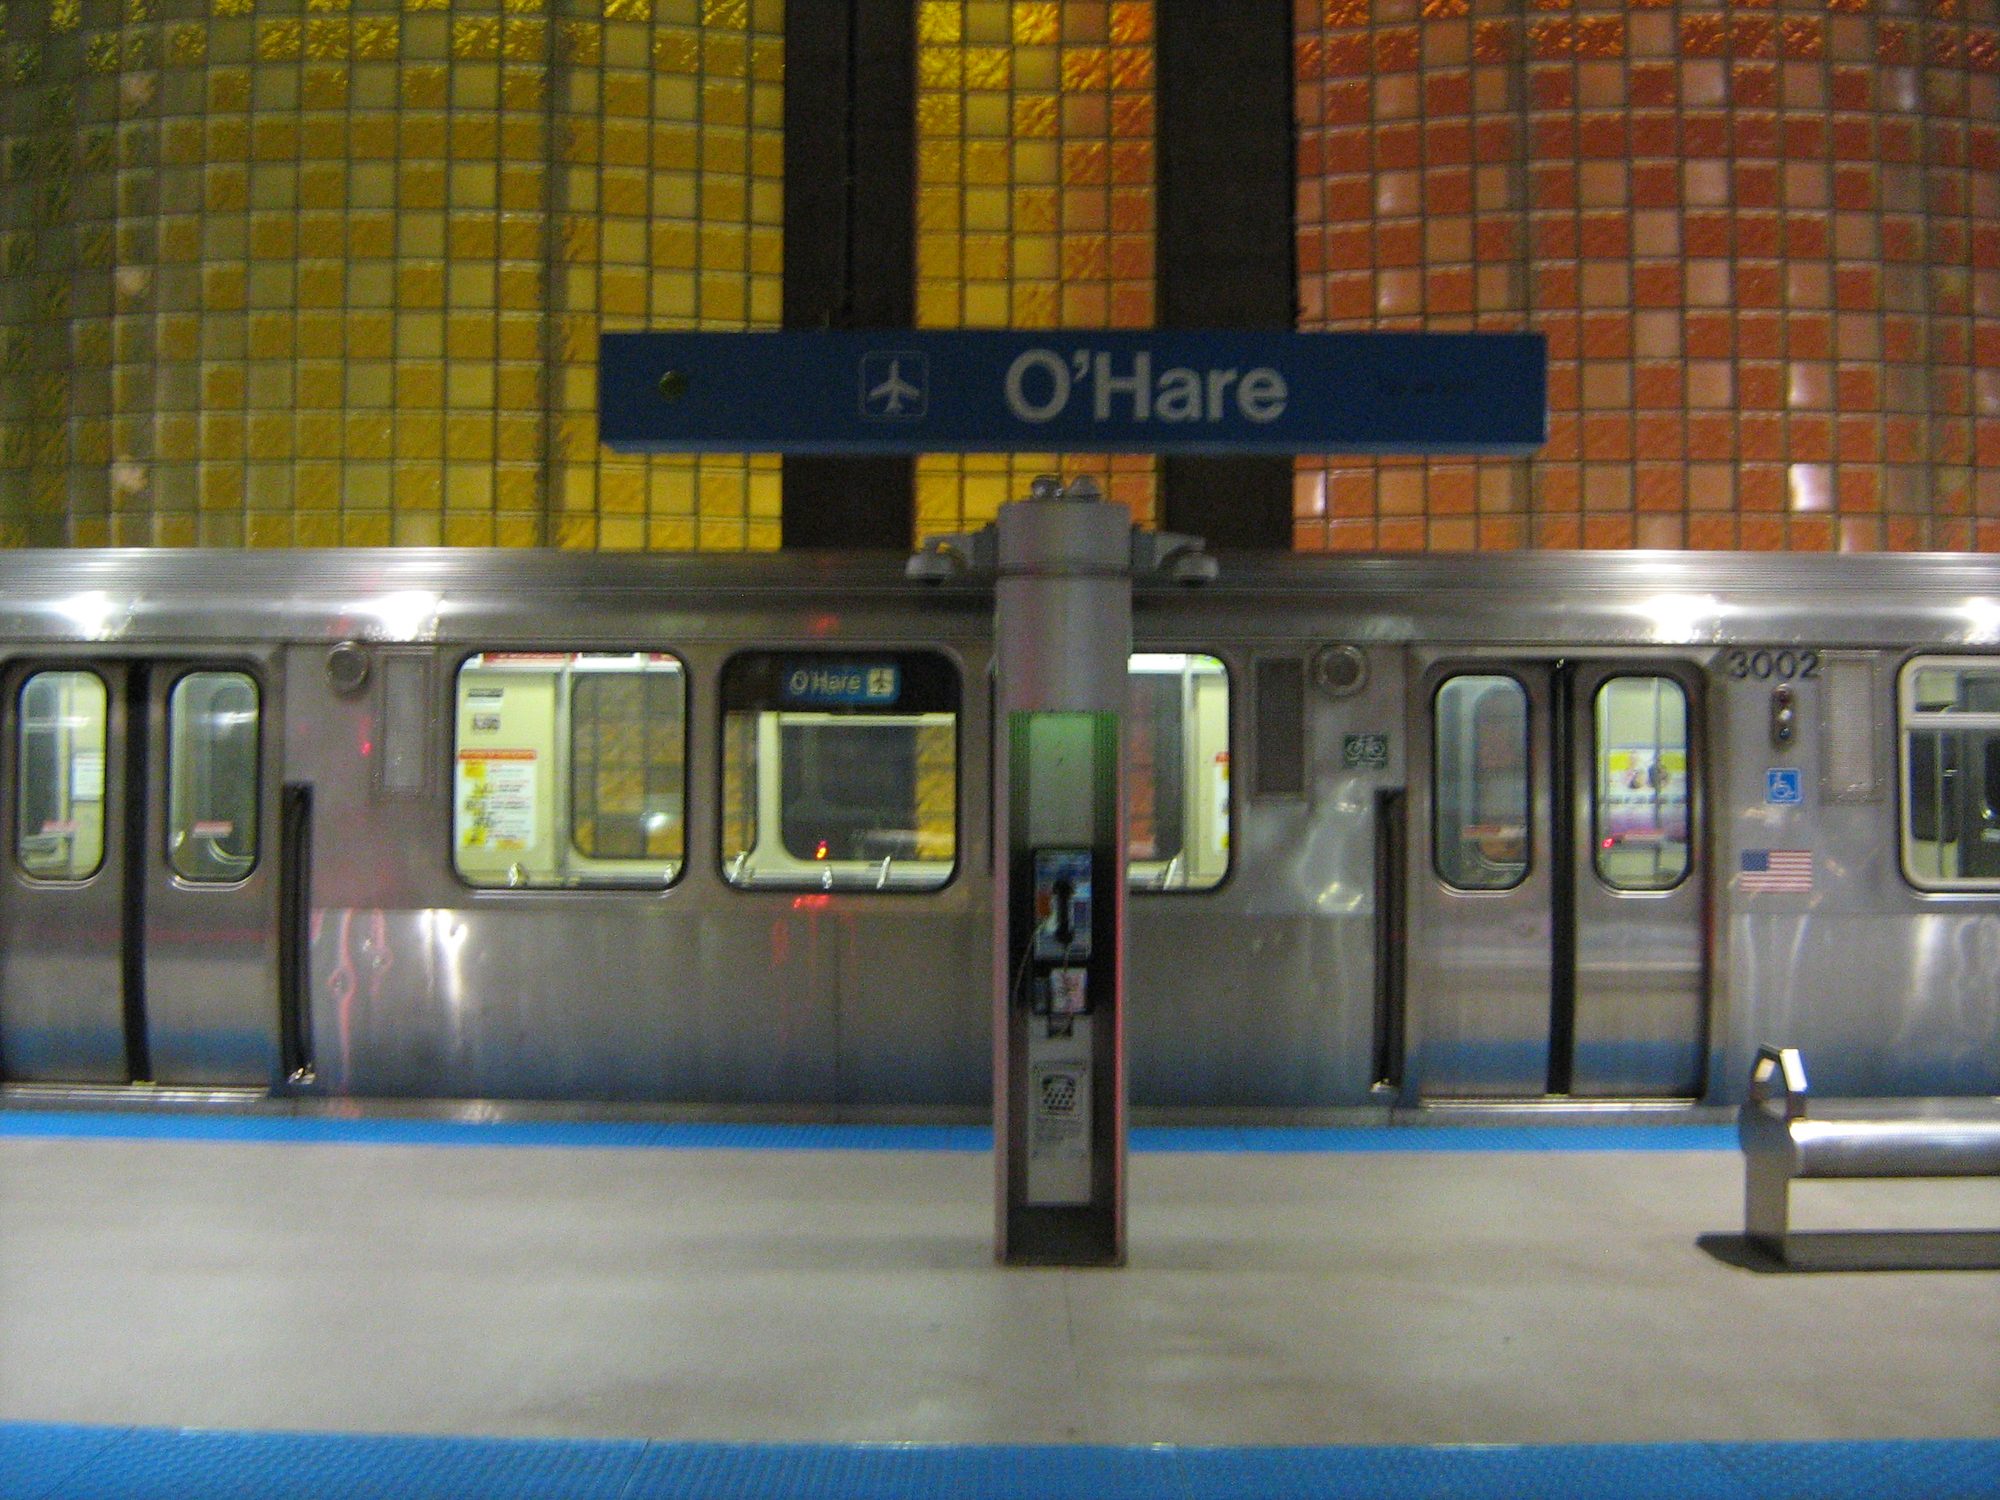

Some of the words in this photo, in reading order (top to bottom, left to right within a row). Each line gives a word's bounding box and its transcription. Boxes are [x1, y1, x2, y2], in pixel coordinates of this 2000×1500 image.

[1005, 348, 1289, 423] O'Hare
[1727, 649, 1820, 679] 3002
[789, 669, 862, 696] O'Hare
